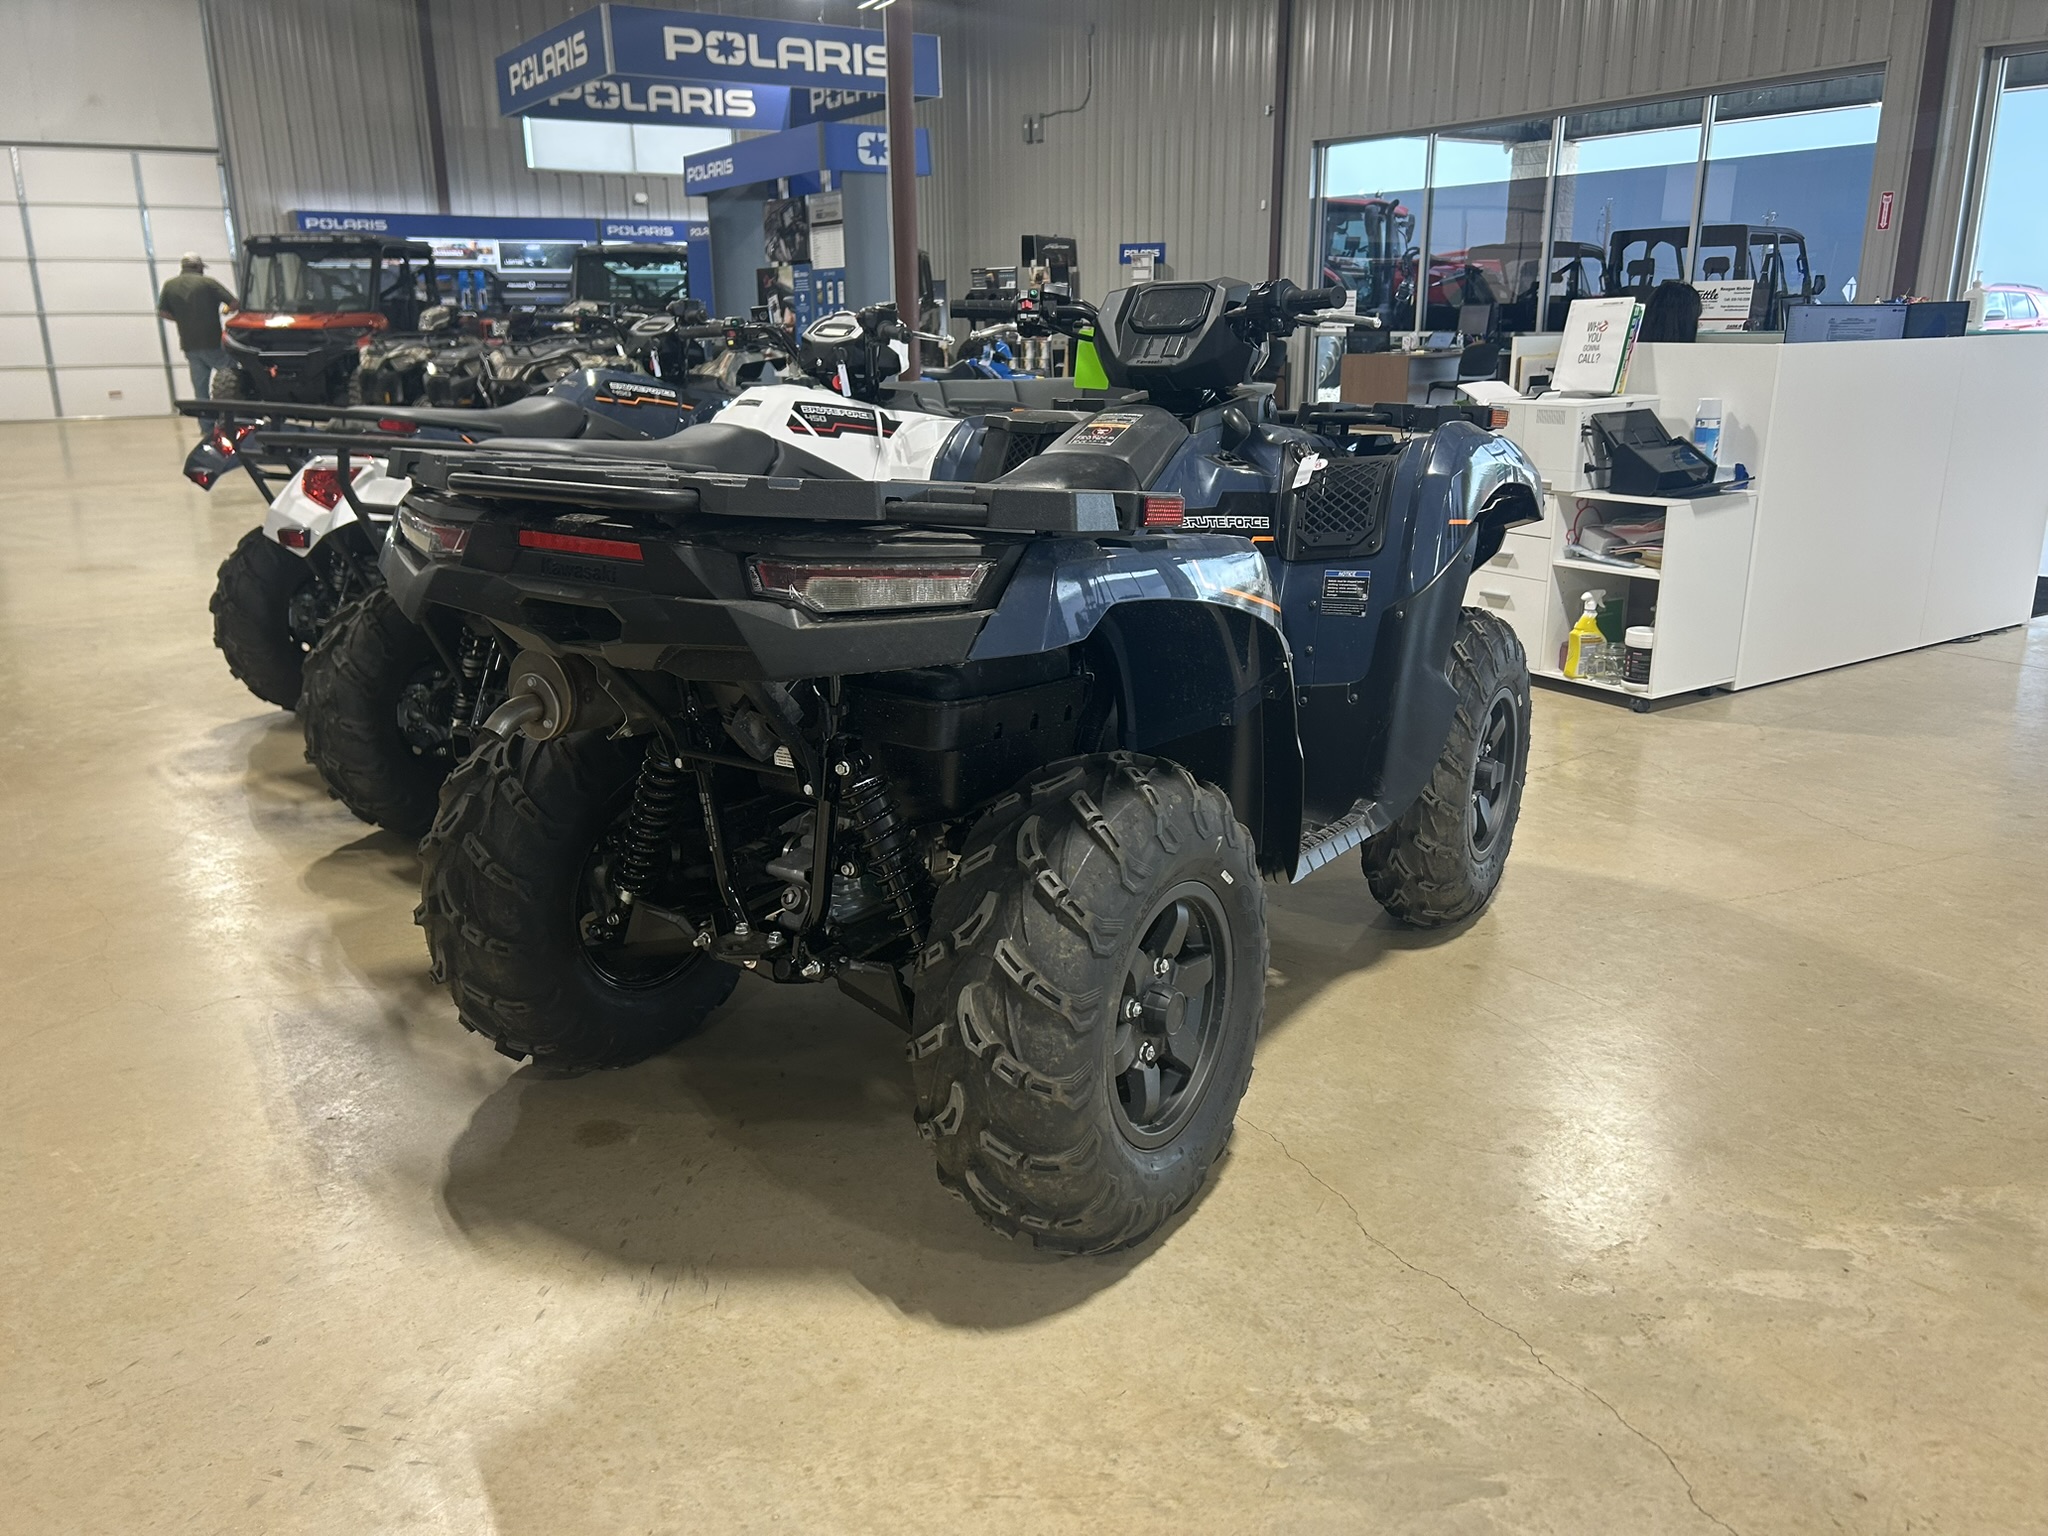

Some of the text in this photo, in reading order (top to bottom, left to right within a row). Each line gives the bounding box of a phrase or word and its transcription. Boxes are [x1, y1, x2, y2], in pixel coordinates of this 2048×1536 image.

[663, 25, 887, 78] POLARIS
[508, 30, 589, 96] POLARIS
[686, 157, 734, 183] POLARIS
[305, 217, 388, 231] POLARIS
[606, 224, 674, 237] POLARIS
[1587, 332, 1602, 343] YOU
[1583, 344, 1600, 352] GONNA
[1577, 353, 1601, 364] CALL?
[804, 414, 827, 423] 450
[540, 557, 617, 583] Kawasaki
